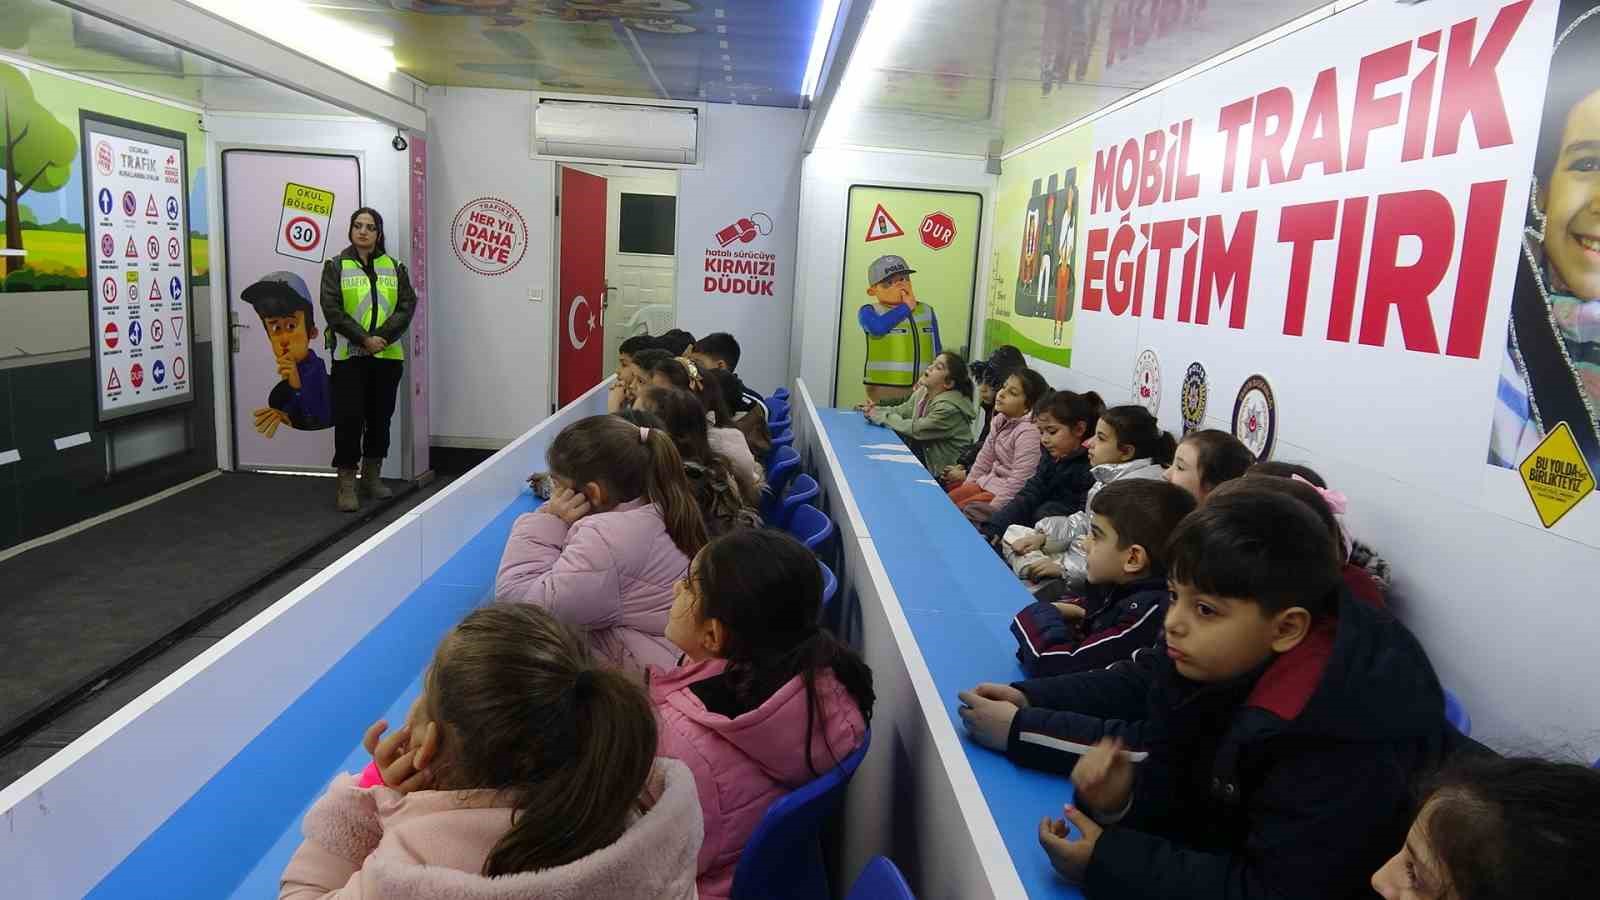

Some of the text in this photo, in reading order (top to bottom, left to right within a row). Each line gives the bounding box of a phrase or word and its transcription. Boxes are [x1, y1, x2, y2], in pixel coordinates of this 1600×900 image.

[1090, 0, 1535, 215] MOBİL TRAFİK
[120, 153, 157, 171] TRAFİK
[297, 188, 323, 201] OKUL
[286, 198, 329, 215] BÖLGESİ
[470, 211, 516, 234] HER YIL
[923, 219, 952, 242] DUR
[293, 226, 312, 242] 30
[466, 223, 511, 248] DAHA
[705, 248, 776, 261] hatalı sürücüye
[704, 258, 775, 276] KIRMIZI
[1081, 210, 1258, 330] EĞİTİM
[1277, 180, 1508, 359] TIRI
[704, 274, 774, 296] DÜDÜK
[1536, 456, 1577, 475] BU YOLDA
